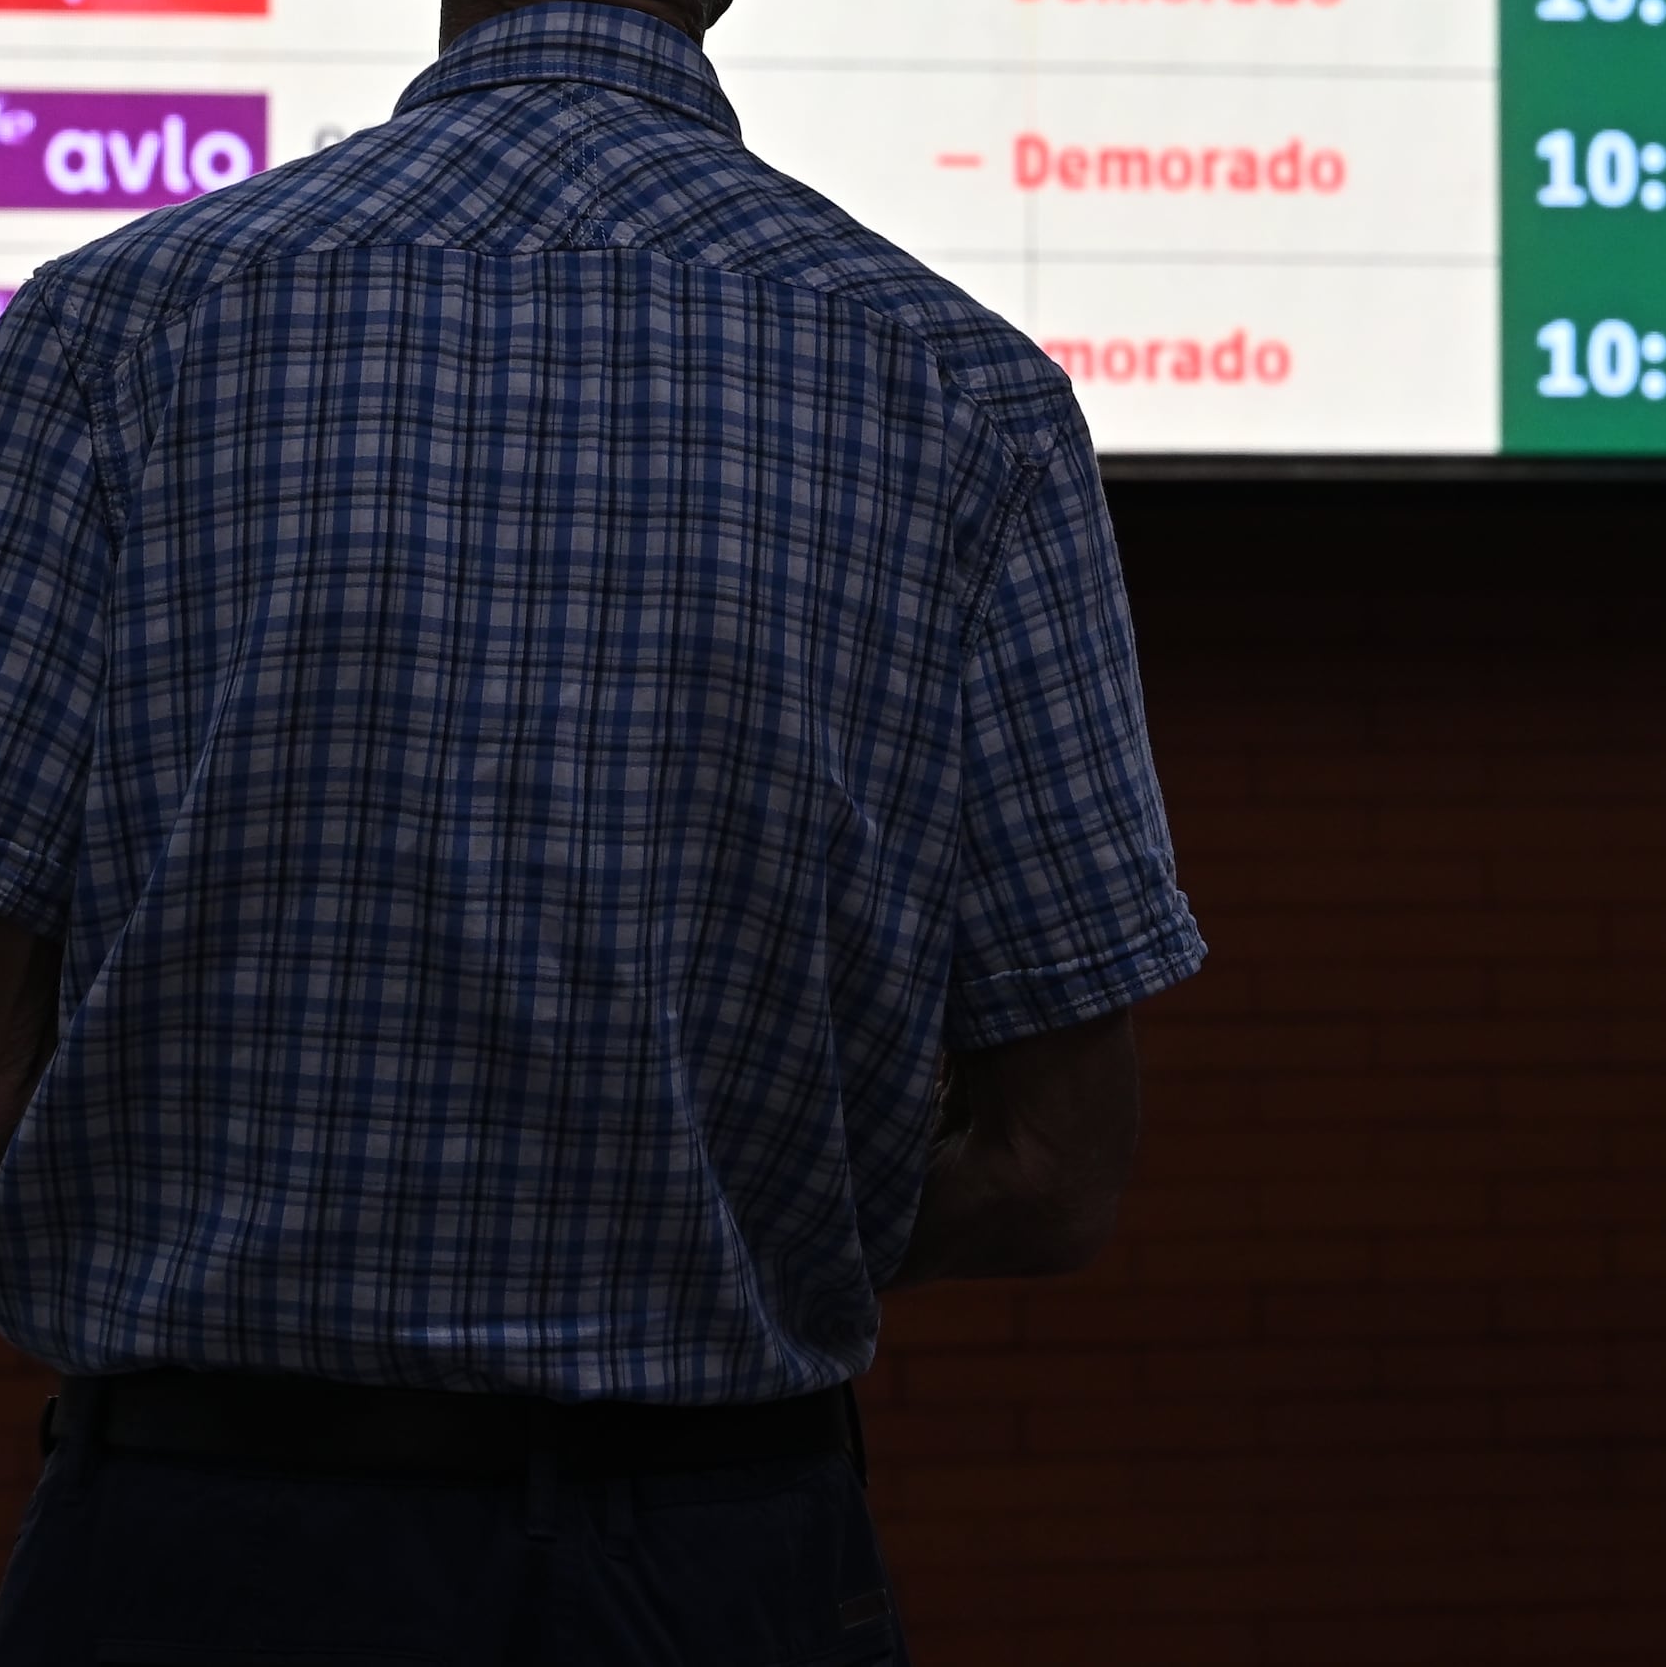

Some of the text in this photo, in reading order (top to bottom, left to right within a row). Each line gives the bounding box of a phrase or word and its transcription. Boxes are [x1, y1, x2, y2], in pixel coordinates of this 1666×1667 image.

[44, 115, 254, 195] avlo
[1011, 130, 1348, 196] Demorado
[1042, 326, 1293, 386] morado
